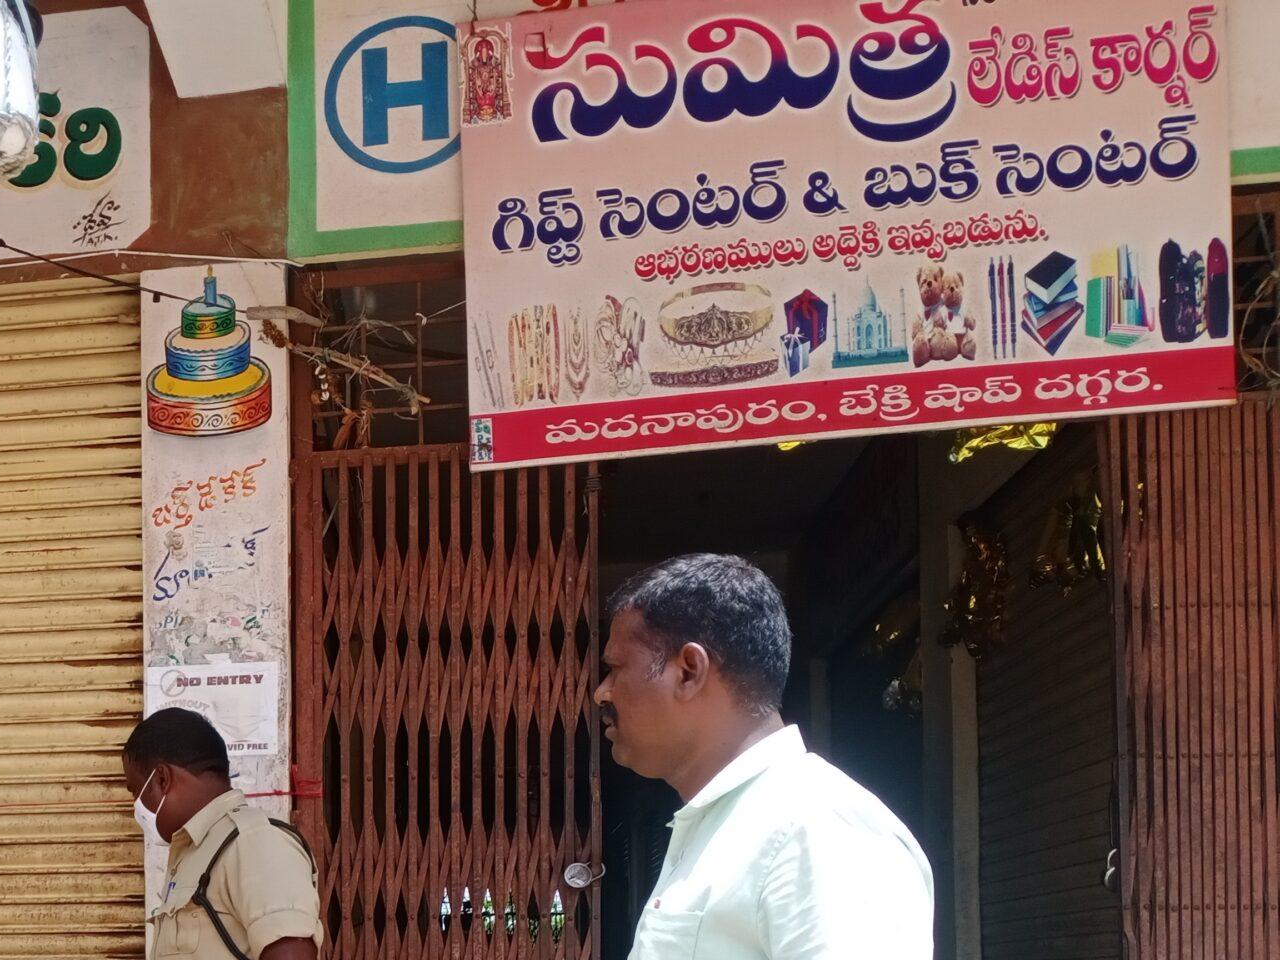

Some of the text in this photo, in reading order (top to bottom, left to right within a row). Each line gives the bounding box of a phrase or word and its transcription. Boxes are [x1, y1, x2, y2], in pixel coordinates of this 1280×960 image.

[525, 0, 957, 143] సుమిత్ర
[596, 158, 787, 241] సెంటర్
[802, 170, 847, 215] &
[863, 139, 982, 208] బుక్
[993, 113, 1199, 200] సెంటర్
[545, 398, 828, 446] మదనాపురం,
[923, 375, 1022, 413] షాప్
[176, 674, 264, 688] NO ENTRY
[246, 743, 269, 751] FREE
